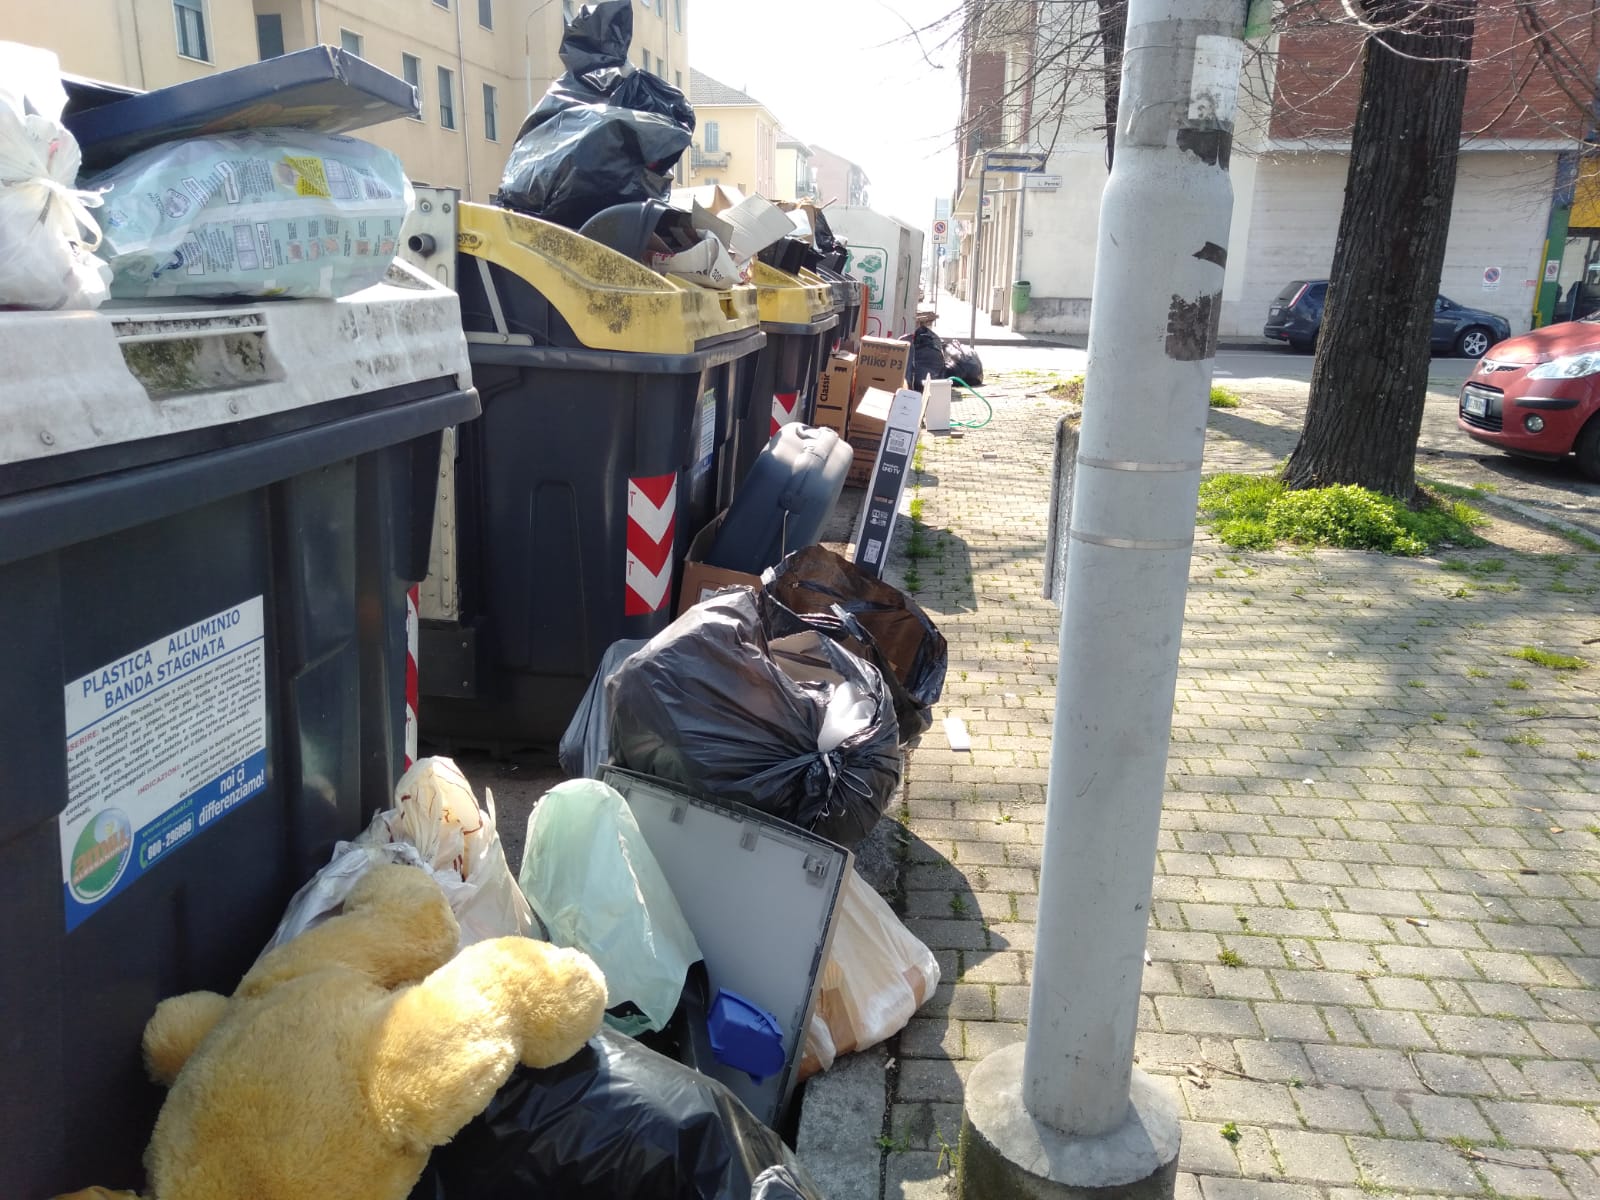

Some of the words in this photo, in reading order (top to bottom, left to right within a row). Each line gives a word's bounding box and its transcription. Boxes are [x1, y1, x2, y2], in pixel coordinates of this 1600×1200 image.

[860, 355, 886, 368] Pliko
[889, 360, 903, 370] P3
[820, 373, 830, 402] Classic
[82, 650, 153, 698] PLASTICA
[167, 609, 241, 656] ALLUMINIO
[104, 671, 154, 709] BANDA
[156, 636, 225, 683] STAGNATA
[198, 769, 265, 826] differenziamo!
[219, 769, 235, 795] noi
[236, 763, 245, 785] ci
